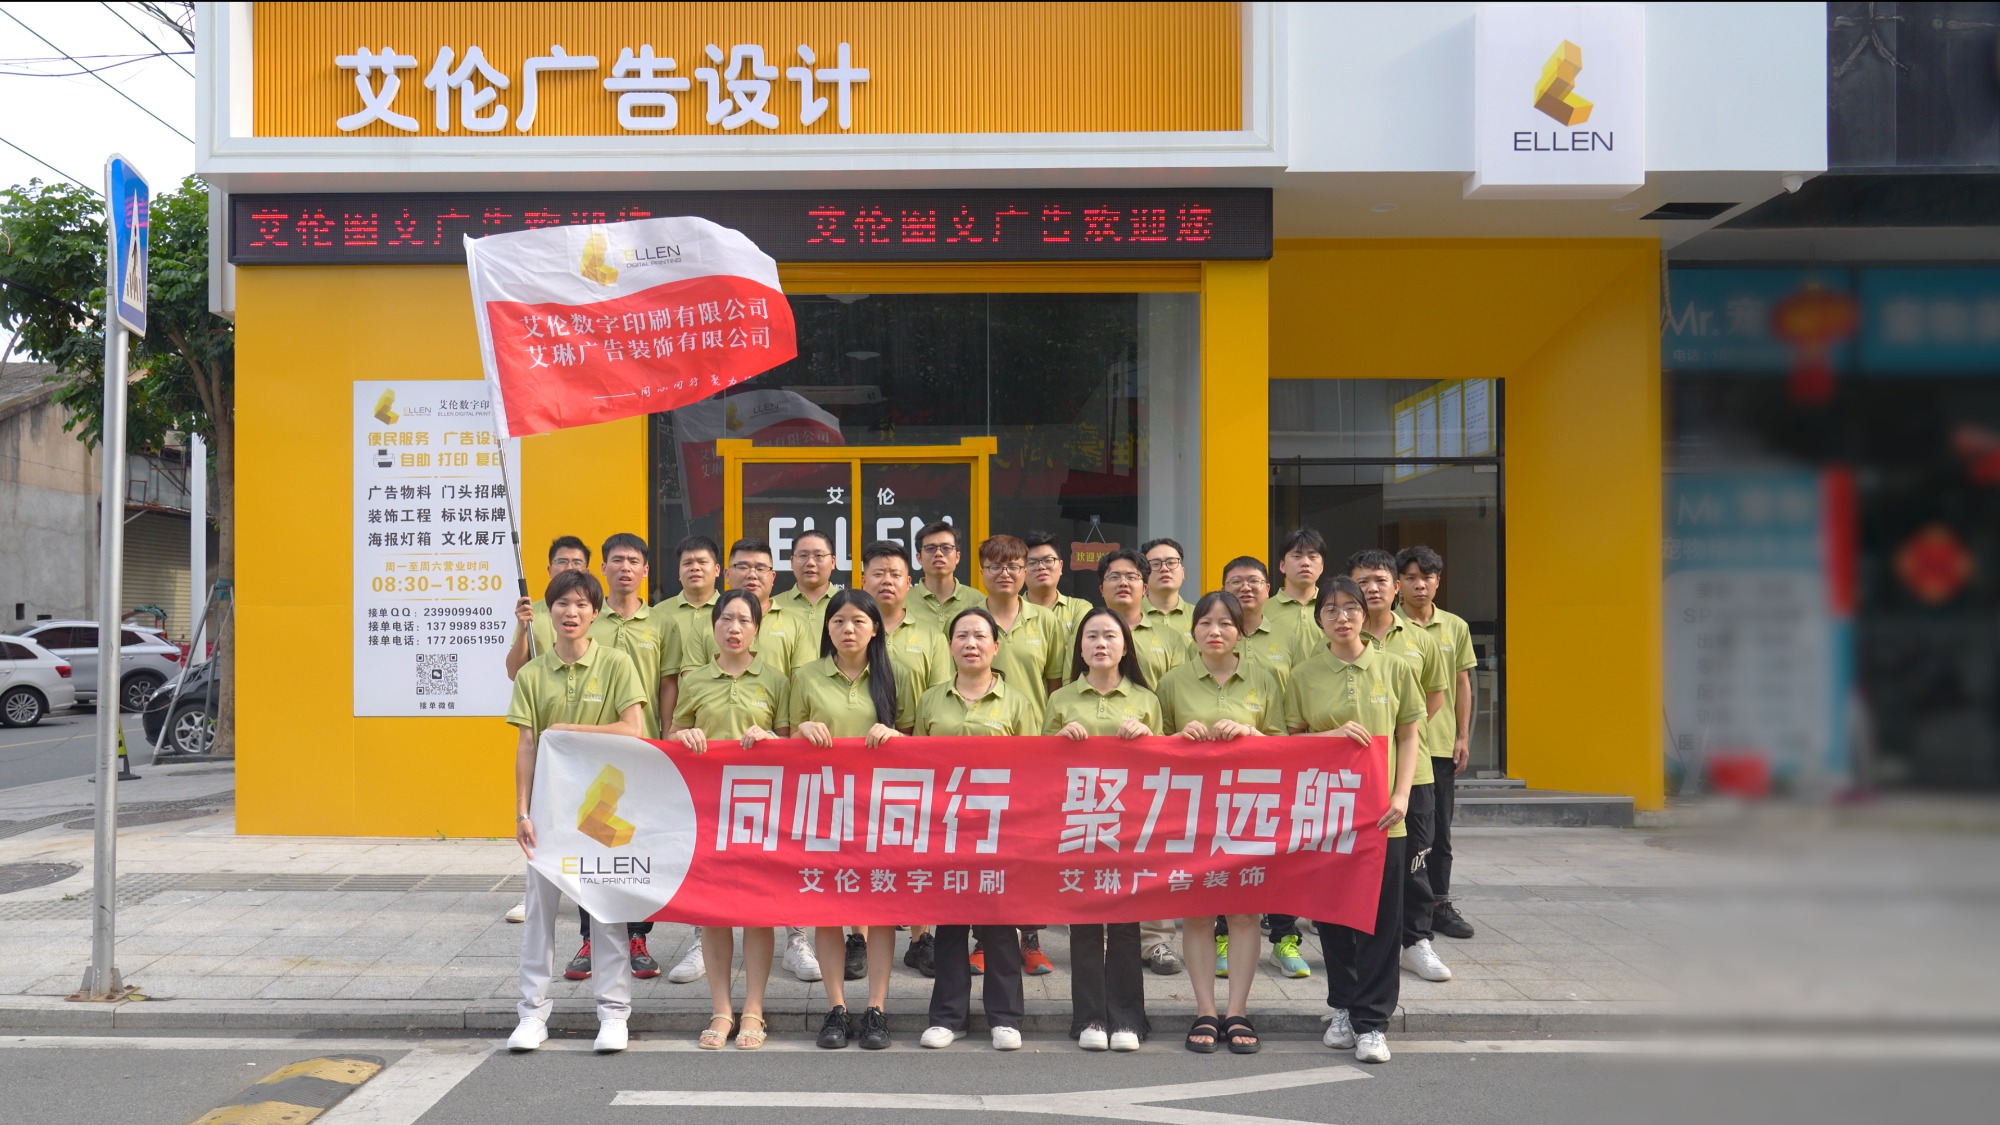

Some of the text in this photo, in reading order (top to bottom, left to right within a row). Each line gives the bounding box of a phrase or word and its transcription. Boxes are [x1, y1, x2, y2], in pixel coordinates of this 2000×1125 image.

[334, 41, 871, 132] 艾伦广告设计
[1513, 131, 1614, 152] ELLEN
[623, 245, 681, 261] ELLEN
[650, 257, 682, 266] PRINTING
[519, 297, 769, 340] 艾伦数字印刷有限公司
[525, 326, 771, 369] 艾琳广告装饰有限公司
[711, 374, 752, 386] 聚力
[368, 431, 430, 446] 便民服务
[400, 452, 431, 467] 自助
[438, 452, 469, 467] 打印
[368, 483, 507, 500] 广告物料 门头招牌
[368, 507, 507, 524] 装饰工程 标识标牌
[368, 530, 506, 547] 海报灯箱 文化展厅
[385, 561, 489, 572] 周一至周六营业时间
[423, 607, 493, 617] 2399099400
[426, 621, 447, 631] 137
[426, 635, 447, 645] 177
[419, 702, 455, 710] 接单微信
[715, 765, 1362, 857] 同心同行 聚力远航
[561, 856, 651, 875] ELLEN
[601, 877, 651, 885] PRINTING
[798, 866, 1266, 895] 艾伦数字印刷 艾琳广告装饰
